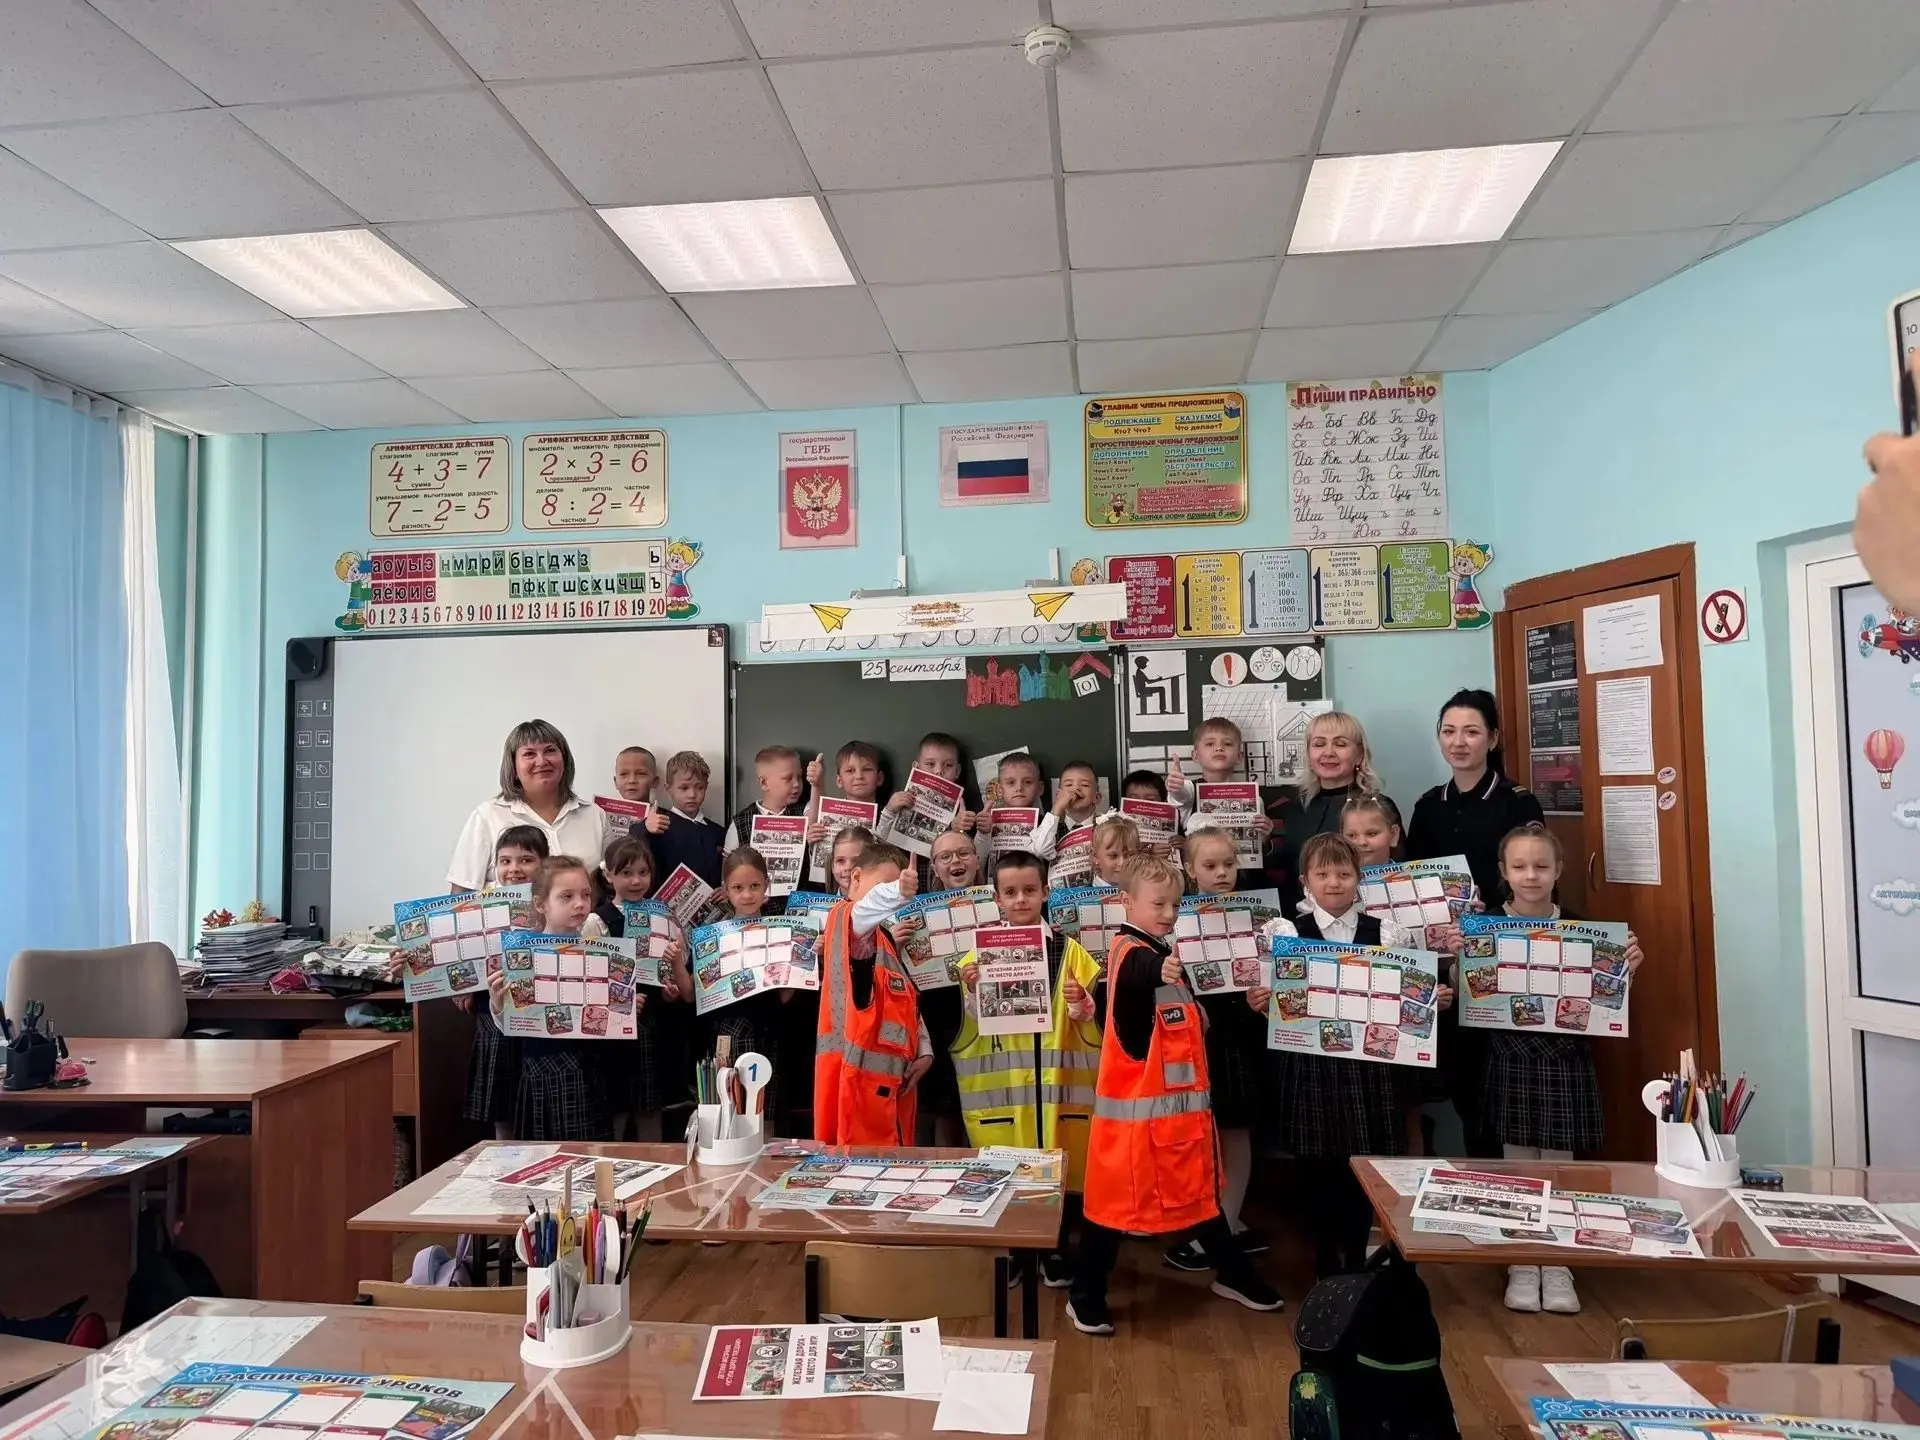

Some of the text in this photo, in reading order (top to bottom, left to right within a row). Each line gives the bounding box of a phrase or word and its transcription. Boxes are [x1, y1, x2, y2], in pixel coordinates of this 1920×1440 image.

[1349, 385, 1437, 401] ПРАВИЛЬНО
[1103, 398, 1226, 411] ГЛАВНЫЕ ЧЛЕНЫ ПРЕДЛОЖЕНИЯ
[1103, 416, 1162, 426] ПОДЛЕЖАЩЕЕ
[1174, 413, 1223, 422] СКАЗУЕМОЕ
[951, 426, 1014, 435] ГОСУДАРСТВЕННЫЙ
[1113, 426, 1152, 435] Кто? Что?
[1175, 423, 1223, 432] Что делает?
[538, 433, 650, 444] АРИФМЕТИЧЕСКИЕ ДЕЙСТВИЯ
[1090, 435, 1239, 449] ВТОРОСТЕПЕННЫЕ ЧЛЕНЫ ПРЕДЛОЖЕНИЯ
[385, 440, 495, 452] АРИФМЕТИЧЕСКИЕ ДЕЙСТВИЯ
[804, 444, 831, 455] ГЕРБ
[1164, 446, 1225, 456] ОПРЕДЕЛЕНИЕ
[1093, 449, 1149, 459] ДОПОЛНЕНИЕ
[388, 456, 492, 483] 4 3 7
[539, 449, 649, 476] 2 3 6
[1165, 460, 1236, 470] ОБСТОЯТЕЛЬСТВО
[387, 497, 491, 523] 7 2 5
[541, 491, 646, 517] 8 2 4
[369, 597, 665, 625] 0 1 2 3 4 5 6 7 8 9 10 11 12 13 14 15 16 17 18 19 20
[863, 661, 885, 676] 25
[1408, 863, 1451, 871] УРОКОВ
[411, 891, 522, 916] РАСПИСАНИЕ УРОКОВ
[909, 889, 970, 910] РАСПИСАНИЕ
[1222, 895, 1262, 904] УРОКОВ
[767, 917, 804, 926] УРОКОВ
[1480, 920, 1609, 939] РАСПИСАНИЕ УРОКОВ
[520, 937, 621, 952] РАСПИСАНИЕ УРОКОВ
[1292, 944, 1418, 966] РАСПИСАНИЕ УРОКОВ
[748, 1063, 758, 1082] 1
[808, 1345, 818, 1357] ДЛЯ
[791, 1337, 806, 1386] ЖЕЛЕЗНАЯ ДОРОГА
[806, 1357, 817, 1376] МЕСТО
[214, 1373, 463, 1398] РАСПИСАНИЕ УРОКОВ
[1581, 1407, 1765, 1425] РАСПИСАНИЕ
